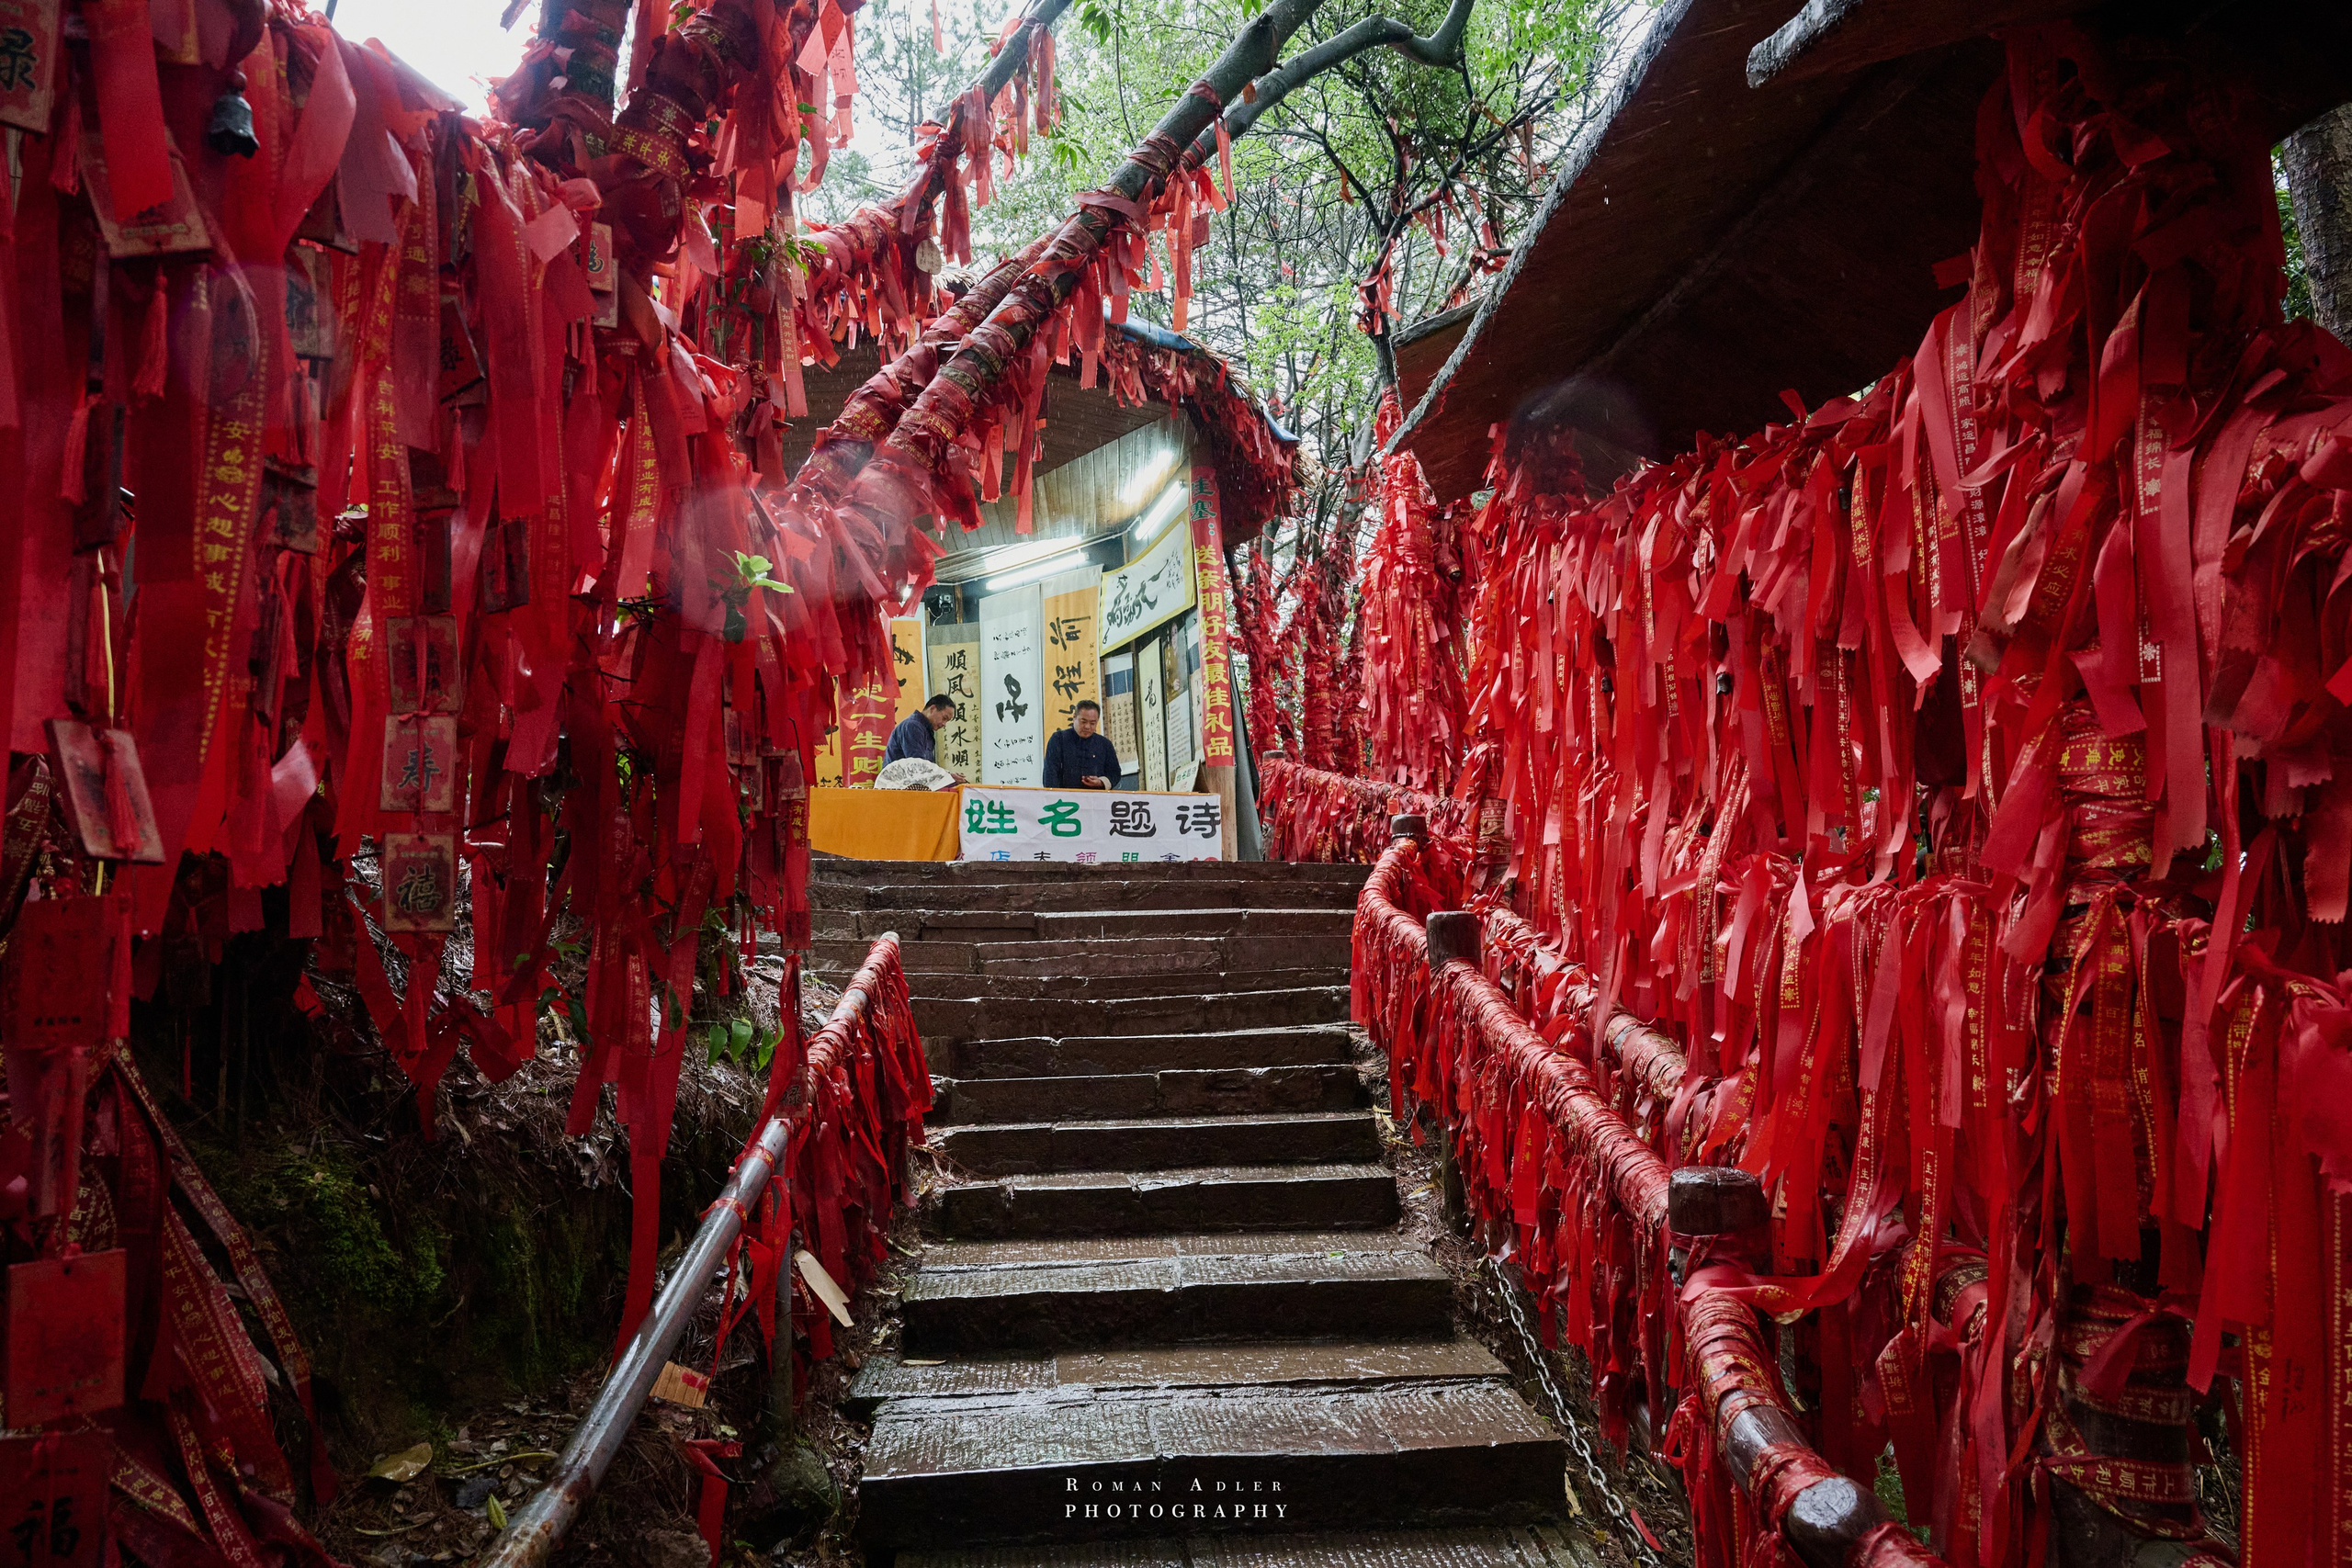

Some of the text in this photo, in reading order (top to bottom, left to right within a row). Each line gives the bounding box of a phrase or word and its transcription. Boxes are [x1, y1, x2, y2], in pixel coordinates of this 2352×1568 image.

[377, 479, 401, 563] 工作顺利
[2042, 529, 2085, 597] 有求必应
[850, 678, 888, 789] 定一生财
[790, 799, 805, 828] 有成
[964, 797, 1221, 840] 姓名题诗
[1861, 1093, 1873, 1148] 身体健康
[1854, 1155, 1871, 1209] 一生平安
[1922, 1149, 1935, 1207] 一生平安
[2096, 1463, 2177, 1495] 工作顺利
[11, 1495, 82, 1562] 福
